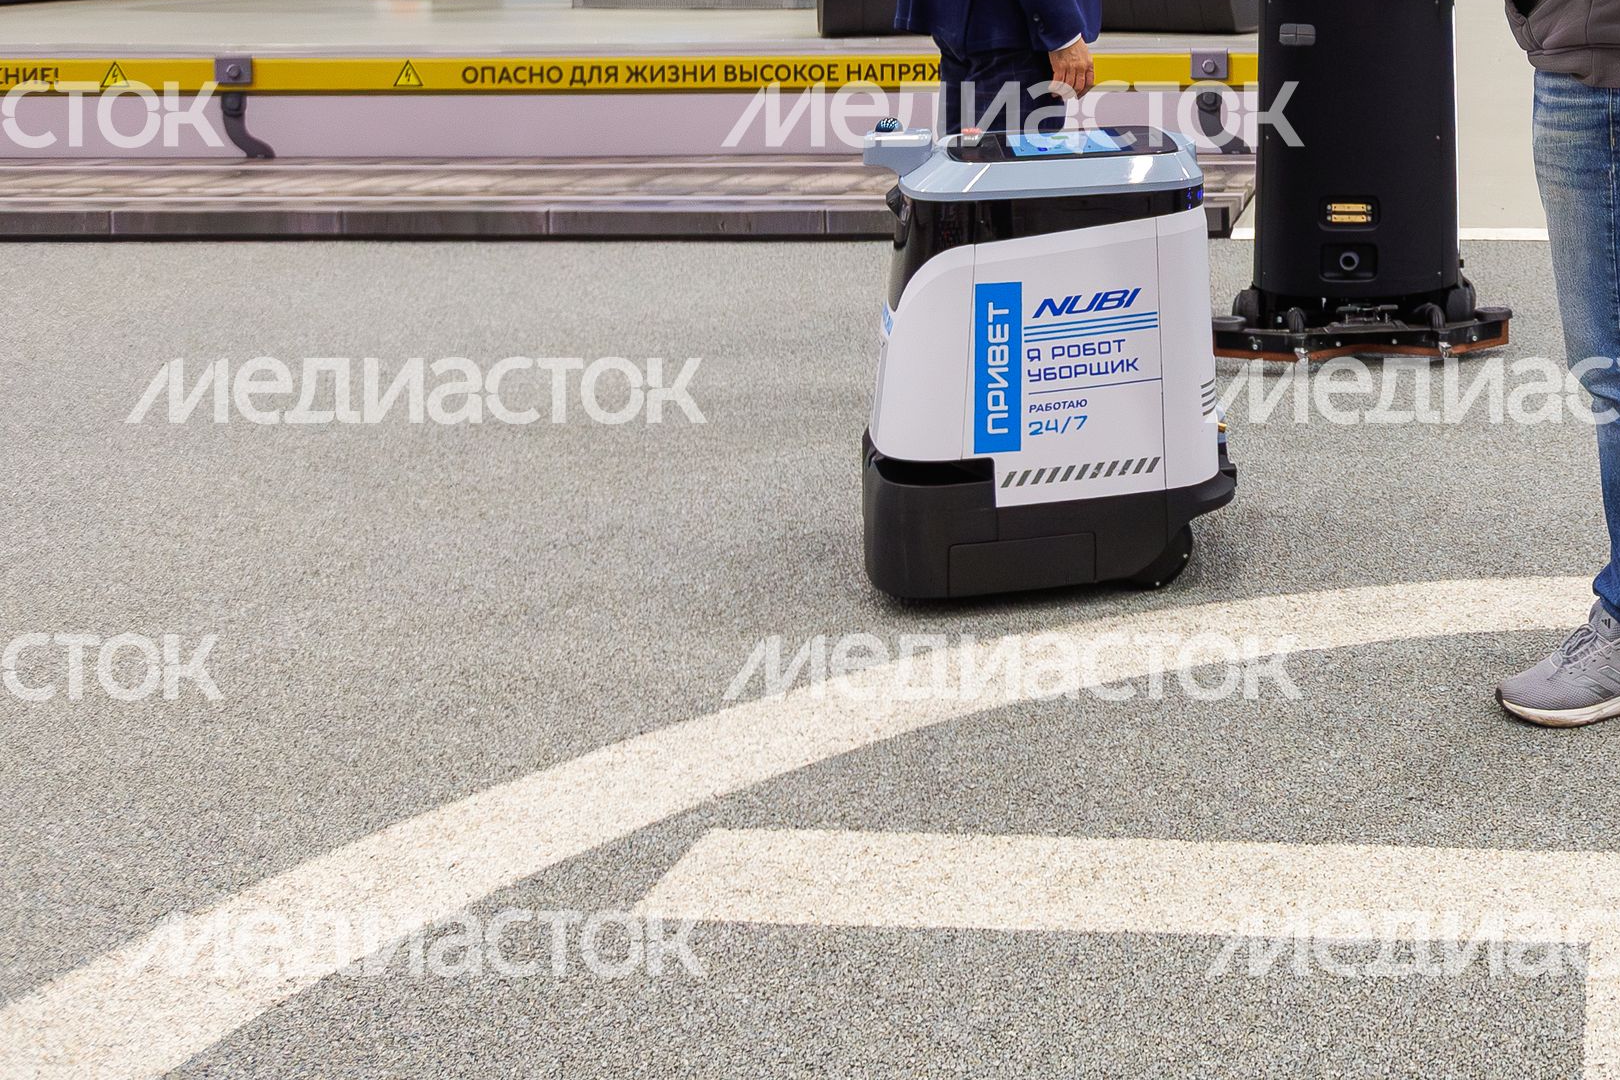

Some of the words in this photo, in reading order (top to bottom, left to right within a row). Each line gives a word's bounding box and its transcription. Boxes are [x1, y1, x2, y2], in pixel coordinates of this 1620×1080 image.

[462, 66, 563, 84] ОПАСНО
[569, 65, 618, 86] ДЛЯ
[625, 65, 716, 83] ЖИЗНИ
[724, 64, 839, 82] ВЫСОКОЕ
[847, 63, 941, 82] НАПРЯЖ
[1032, 288, 1142, 318] NUBI
[1027, 348, 1041, 362] Я
[1051, 339, 1126, 360] РОБОТ
[987, 302, 1010, 434] ПРИВЕТ
[1028, 358, 1139, 382] УБОРЩИК
[1029, 399, 1088, 413] РАБОТАЮ
[1029, 415, 1088, 436] 24/7
